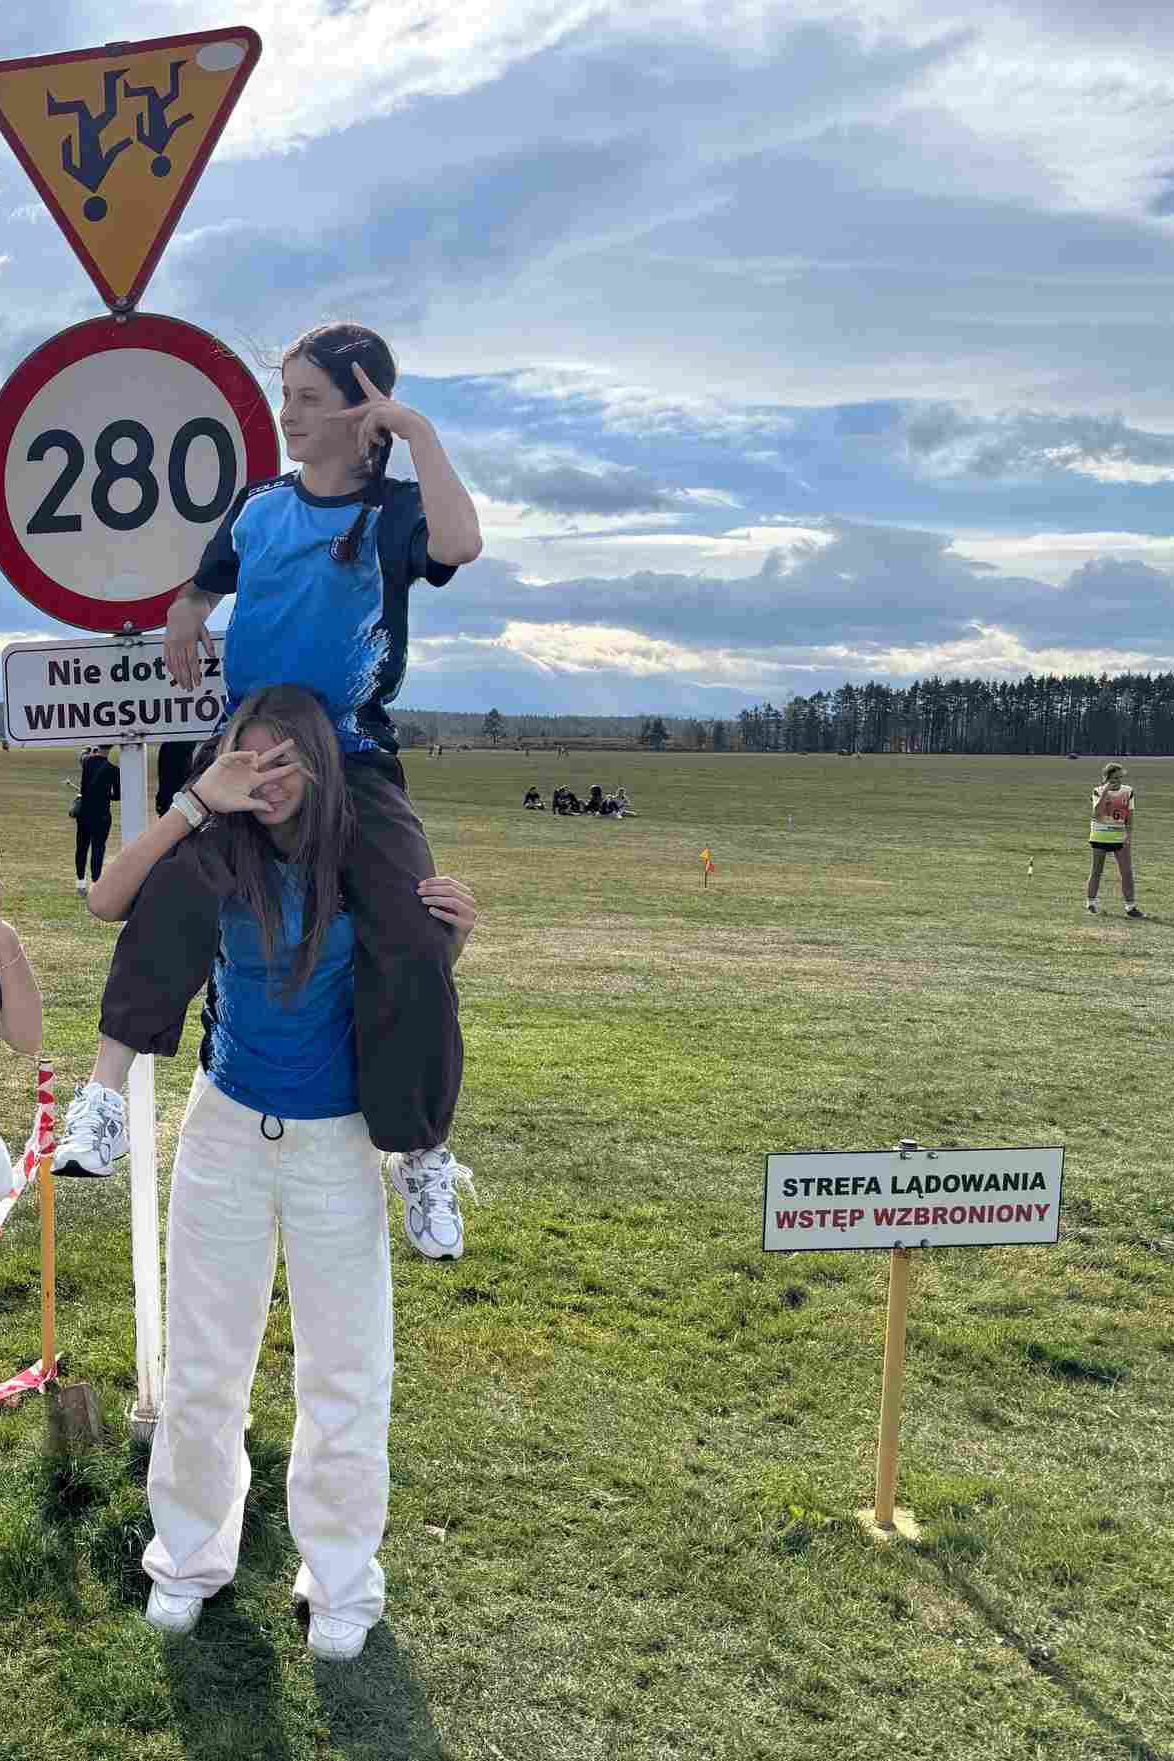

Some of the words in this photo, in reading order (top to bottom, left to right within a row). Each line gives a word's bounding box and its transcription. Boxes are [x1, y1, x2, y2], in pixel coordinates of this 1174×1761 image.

[26, 417, 237, 535] 280
[48, 658, 101, 686] Nie
[782, 1176, 882, 1197] STREFA
[891, 1172, 1046, 1199] LĄDOWANIA
[776, 1208, 865, 1232] WSTĘP
[873, 1203, 1051, 1226] WZBRONIONY
